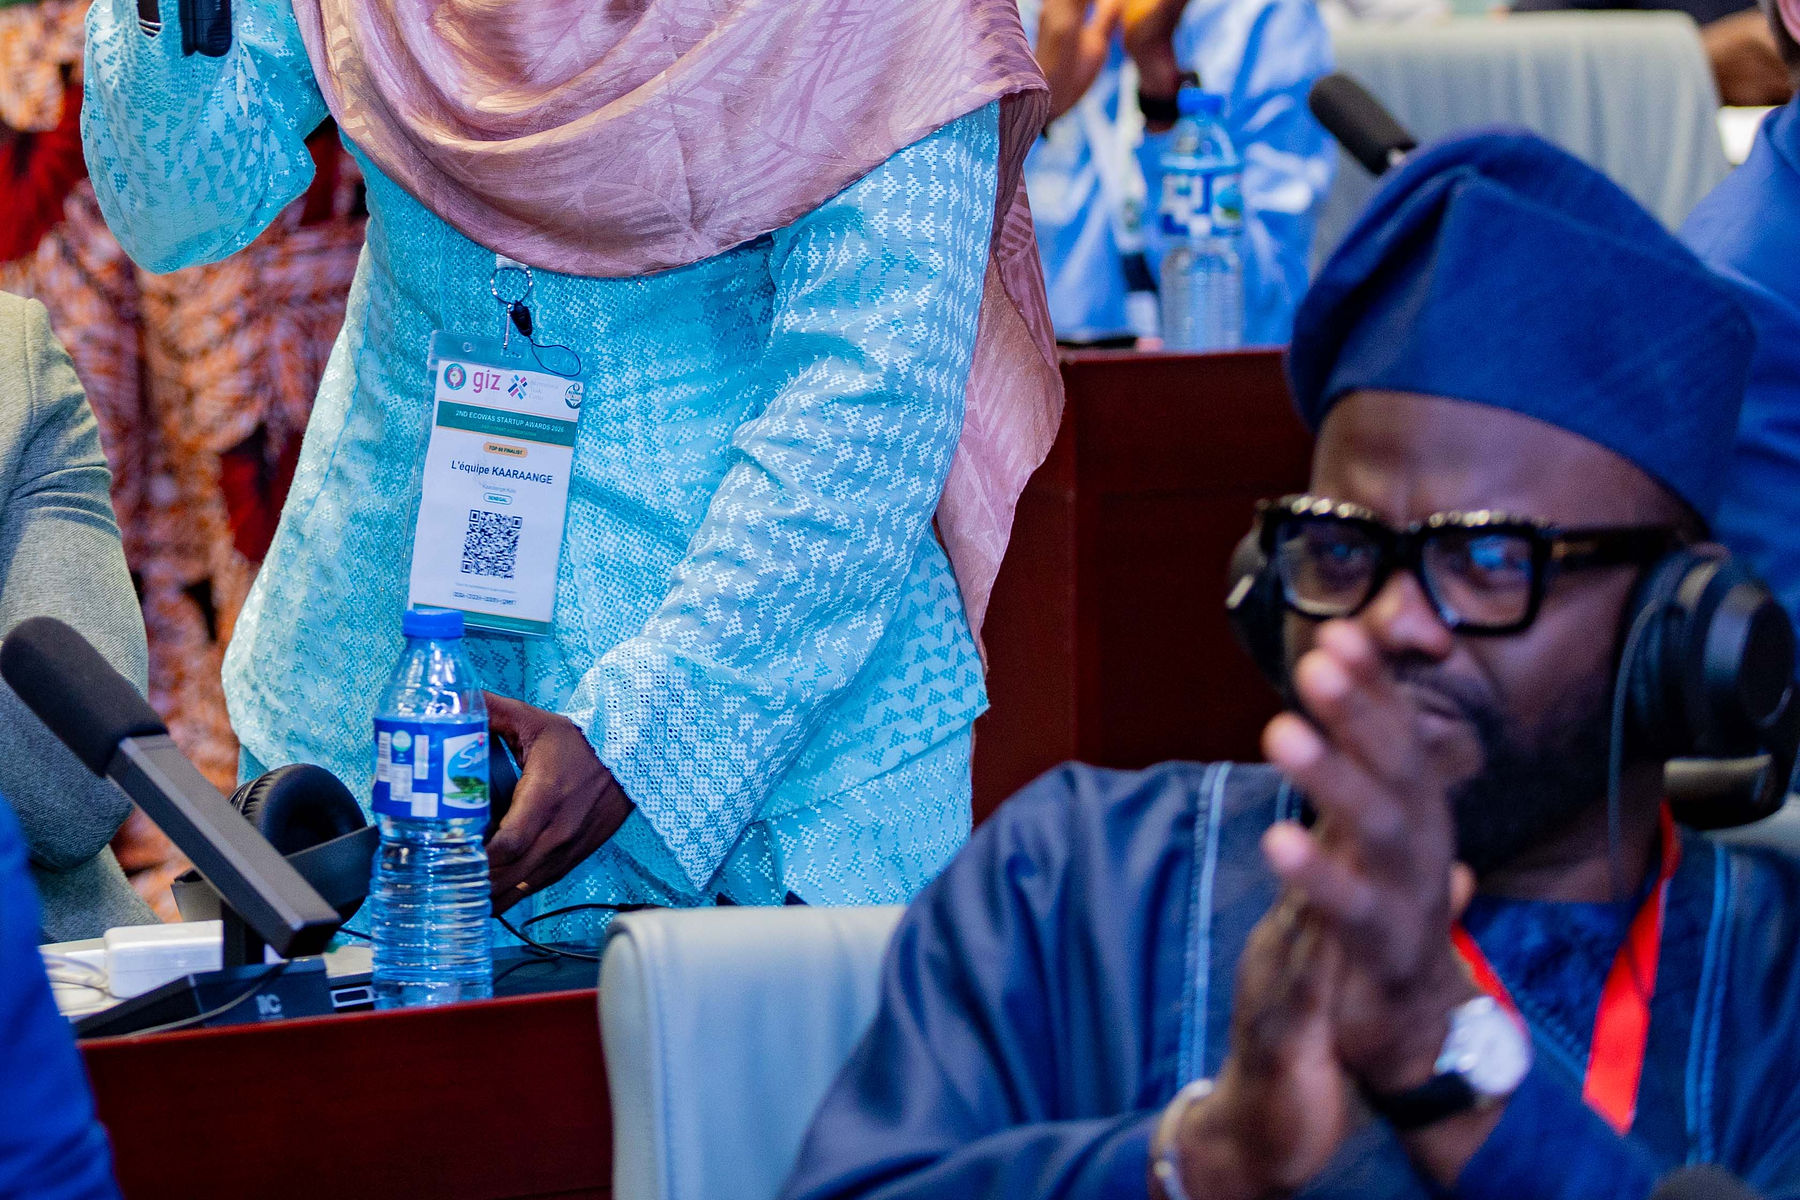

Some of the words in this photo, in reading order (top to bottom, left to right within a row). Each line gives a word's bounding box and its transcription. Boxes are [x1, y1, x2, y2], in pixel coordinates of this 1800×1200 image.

[473, 369, 502, 394] giz
[469, 412, 496, 422] ECOWAS
[496, 416, 524, 426] STARTUP
[525, 421, 551, 431] AWARDS
[450, 460, 490, 475] L'équipe
[492, 466, 553, 484] KAARAANGE
